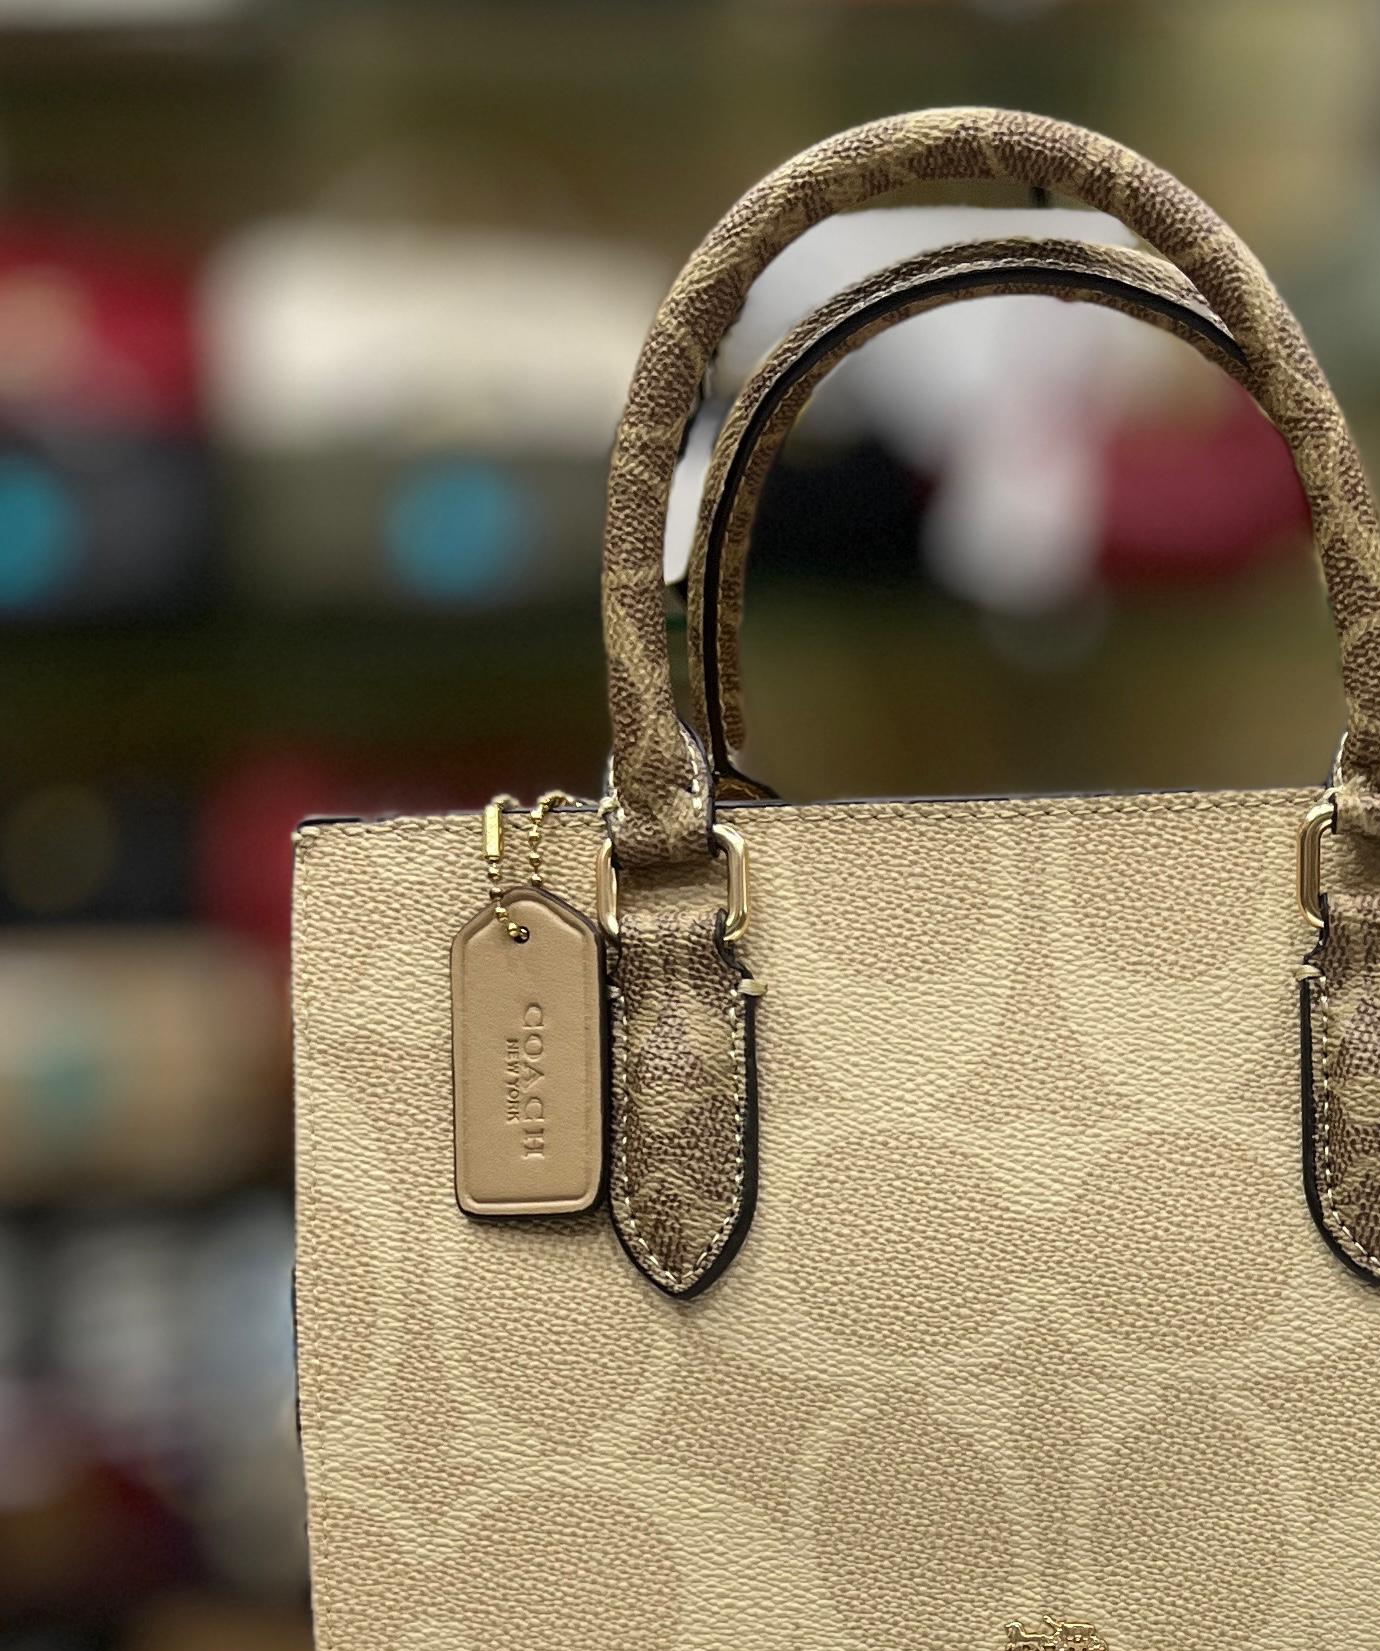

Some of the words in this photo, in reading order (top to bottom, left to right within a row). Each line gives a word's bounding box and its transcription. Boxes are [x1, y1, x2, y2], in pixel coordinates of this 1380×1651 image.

[506, 1037, 520, 1076] NEW
[506, 1077, 520, 1125] YORK
[523, 1002, 545, 1160] COACH
